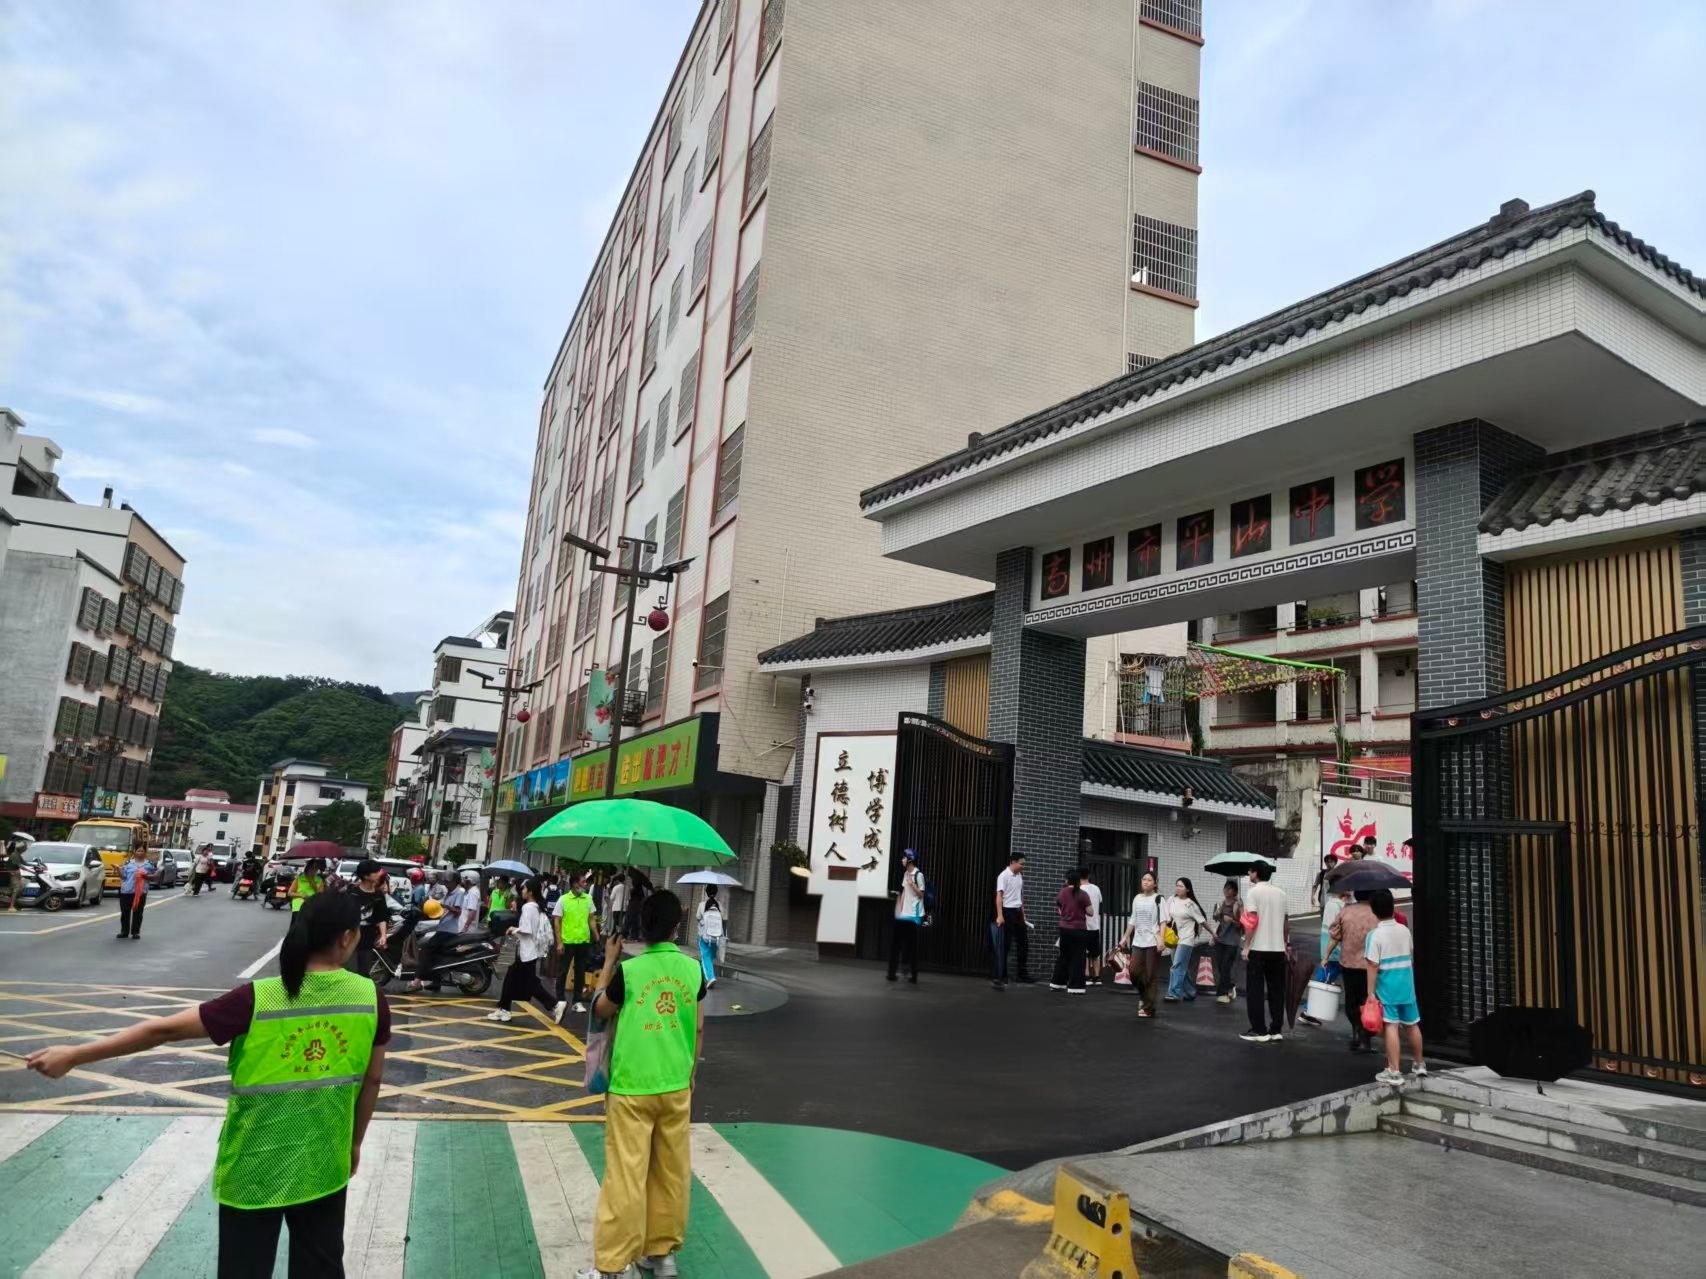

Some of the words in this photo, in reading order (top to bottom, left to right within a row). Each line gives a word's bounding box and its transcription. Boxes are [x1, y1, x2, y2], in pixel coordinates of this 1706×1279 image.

[1046, 465, 1401, 595] 高州市平山中学
[824, 750, 852, 861] 立德树人
[861, 768, 889, 872] 博学成才
